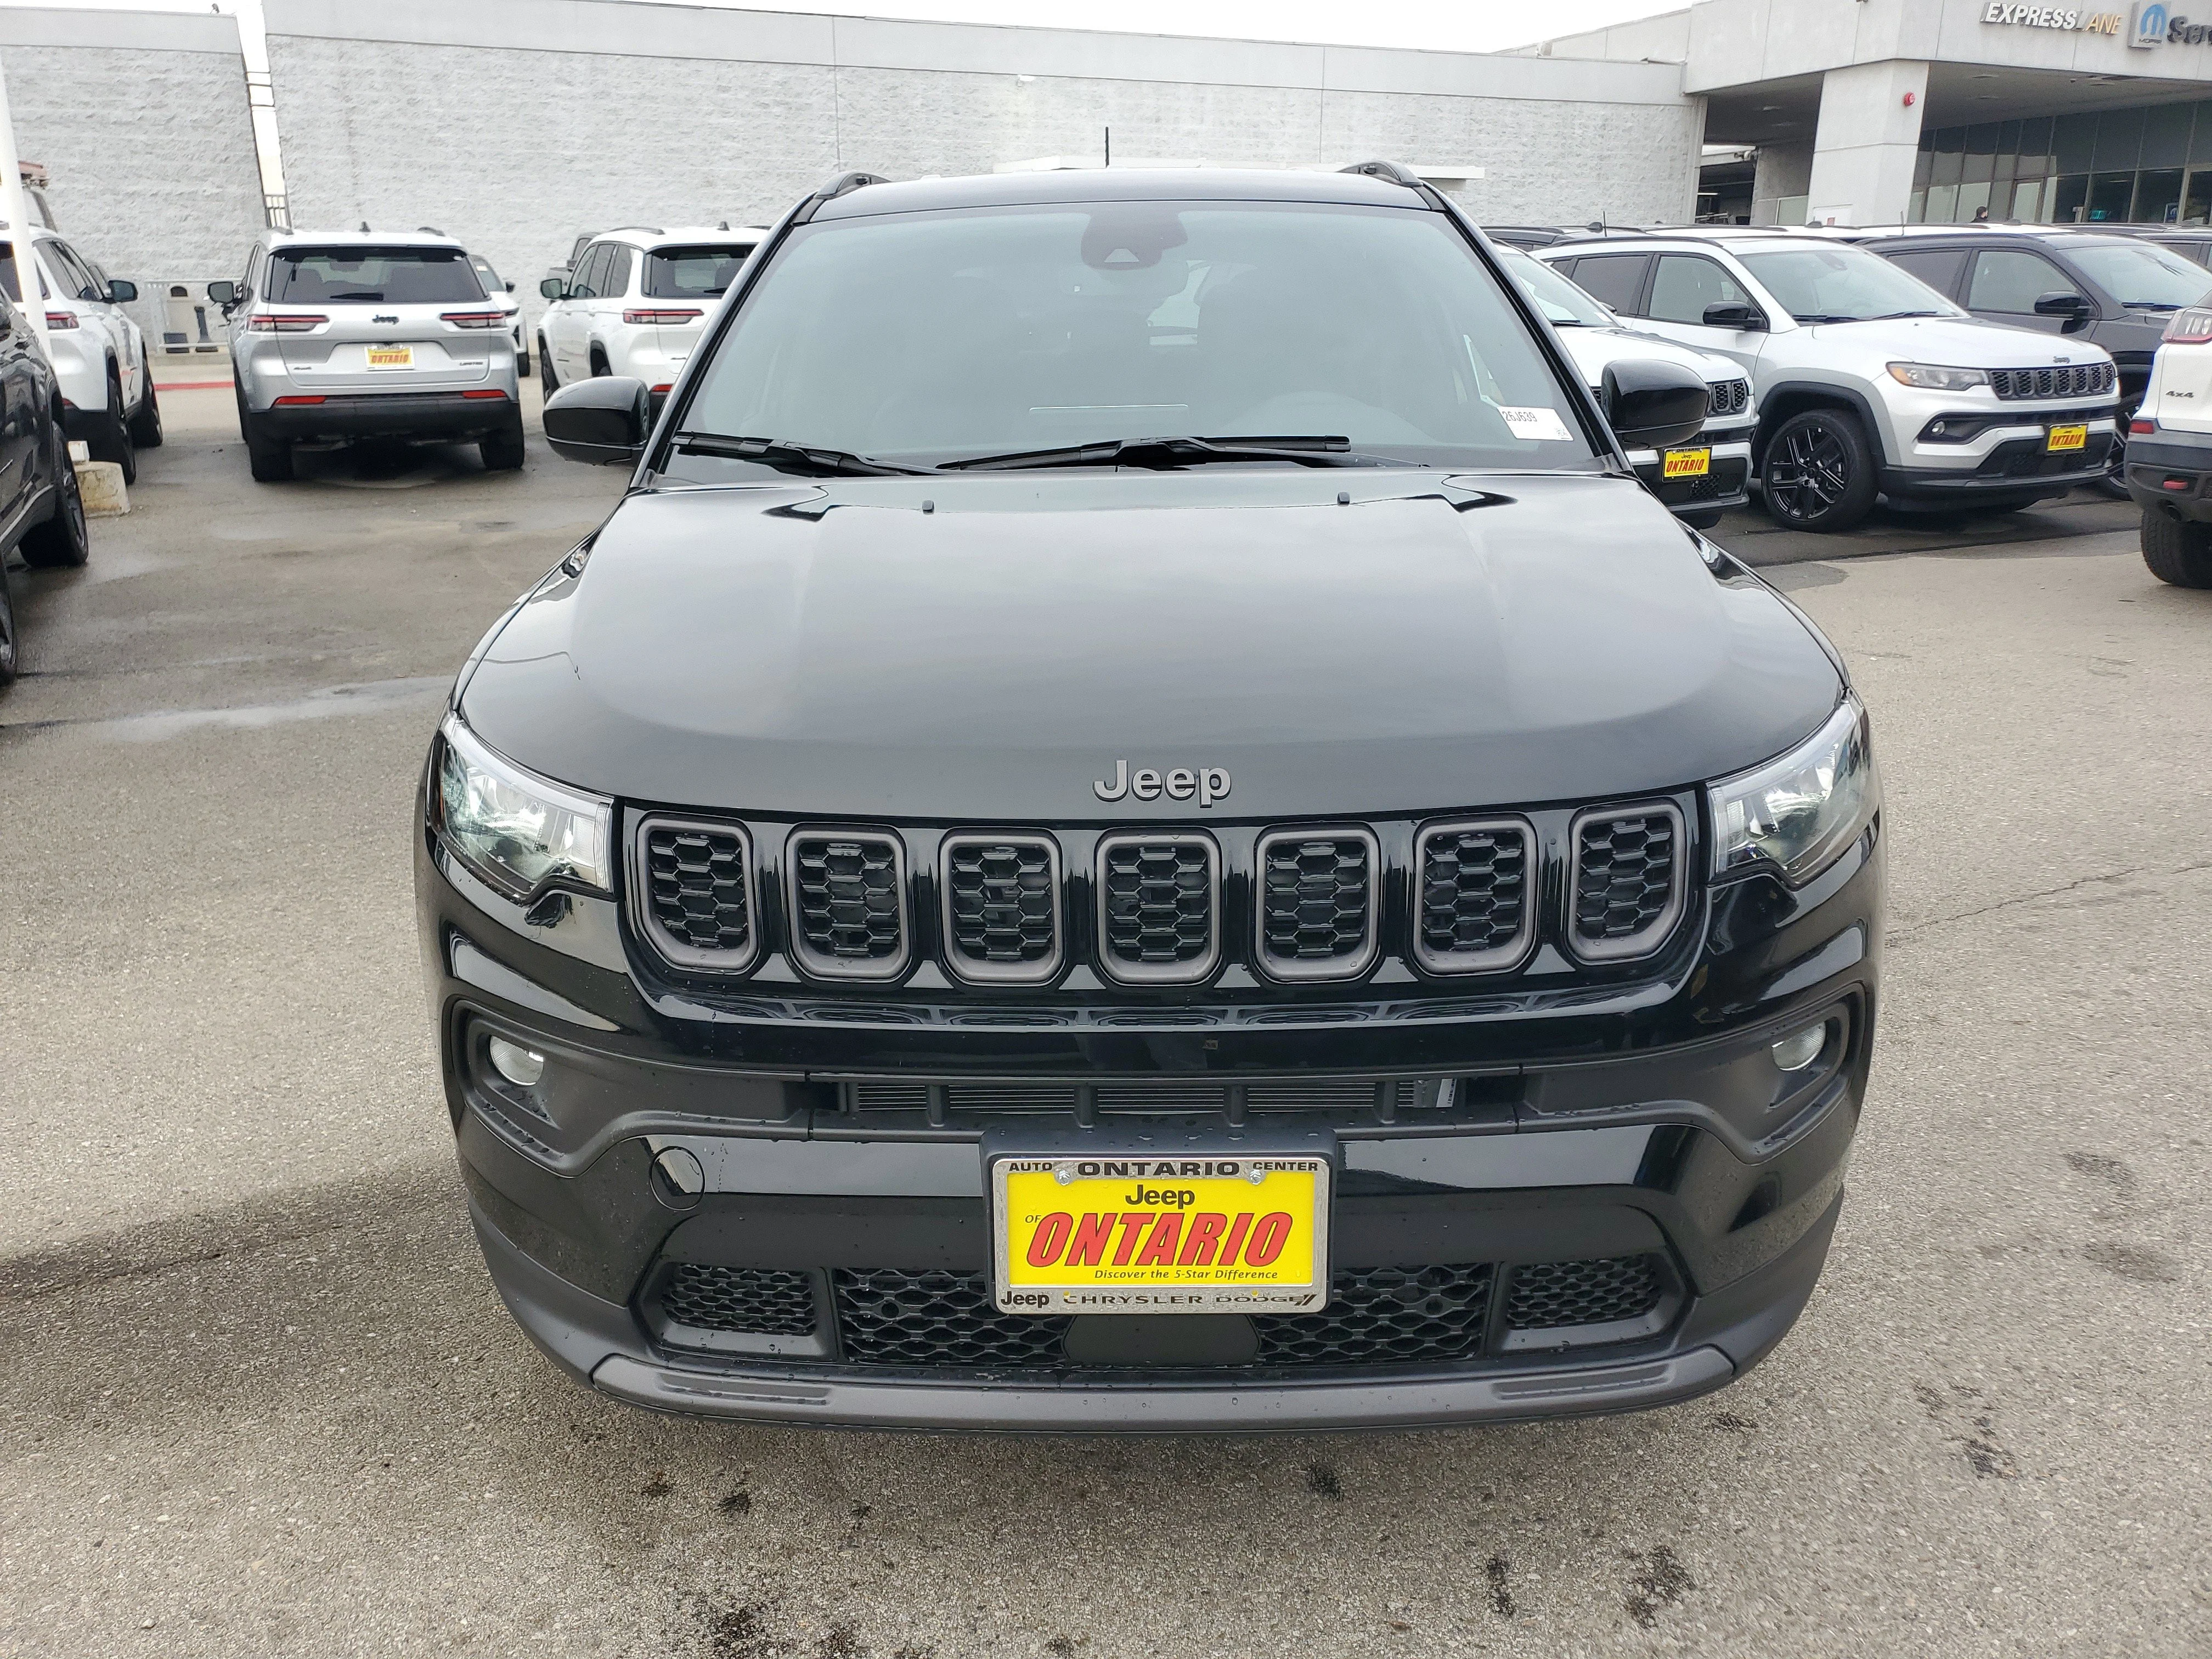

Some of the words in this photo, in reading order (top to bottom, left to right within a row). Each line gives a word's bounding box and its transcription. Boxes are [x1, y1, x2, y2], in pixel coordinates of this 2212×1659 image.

[1982, 2, 2078, 30] EXPRESS
[2167, 16, 2212, 44] Ser
[1502, 411, 1537, 421] 26J639
[1666, 459, 1705, 472] ONTARIO
[1093, 759, 1231, 808] Jeep
[1008, 1162, 1053, 1171] AUTO
[1077, 1161, 1240, 1176] ONTARIO
[1252, 1161, 1318, 1171] CENTER
[1125, 1184, 1195, 1210] Jeep
[1025, 1215, 1041, 1223] OF
[1026, 1211, 1293, 1267] ONTARIO
[1094, 1270, 1147, 1278] Discover
[1150, 1270, 1169, 1278] the
[1174, 1270, 1211, 1278] 5-Star
[1215, 1270, 1278, 1280] Difference
[1000, 1291, 1049, 1308] Jeep
[1064, 1295, 1204, 1304] CHRYSLER
